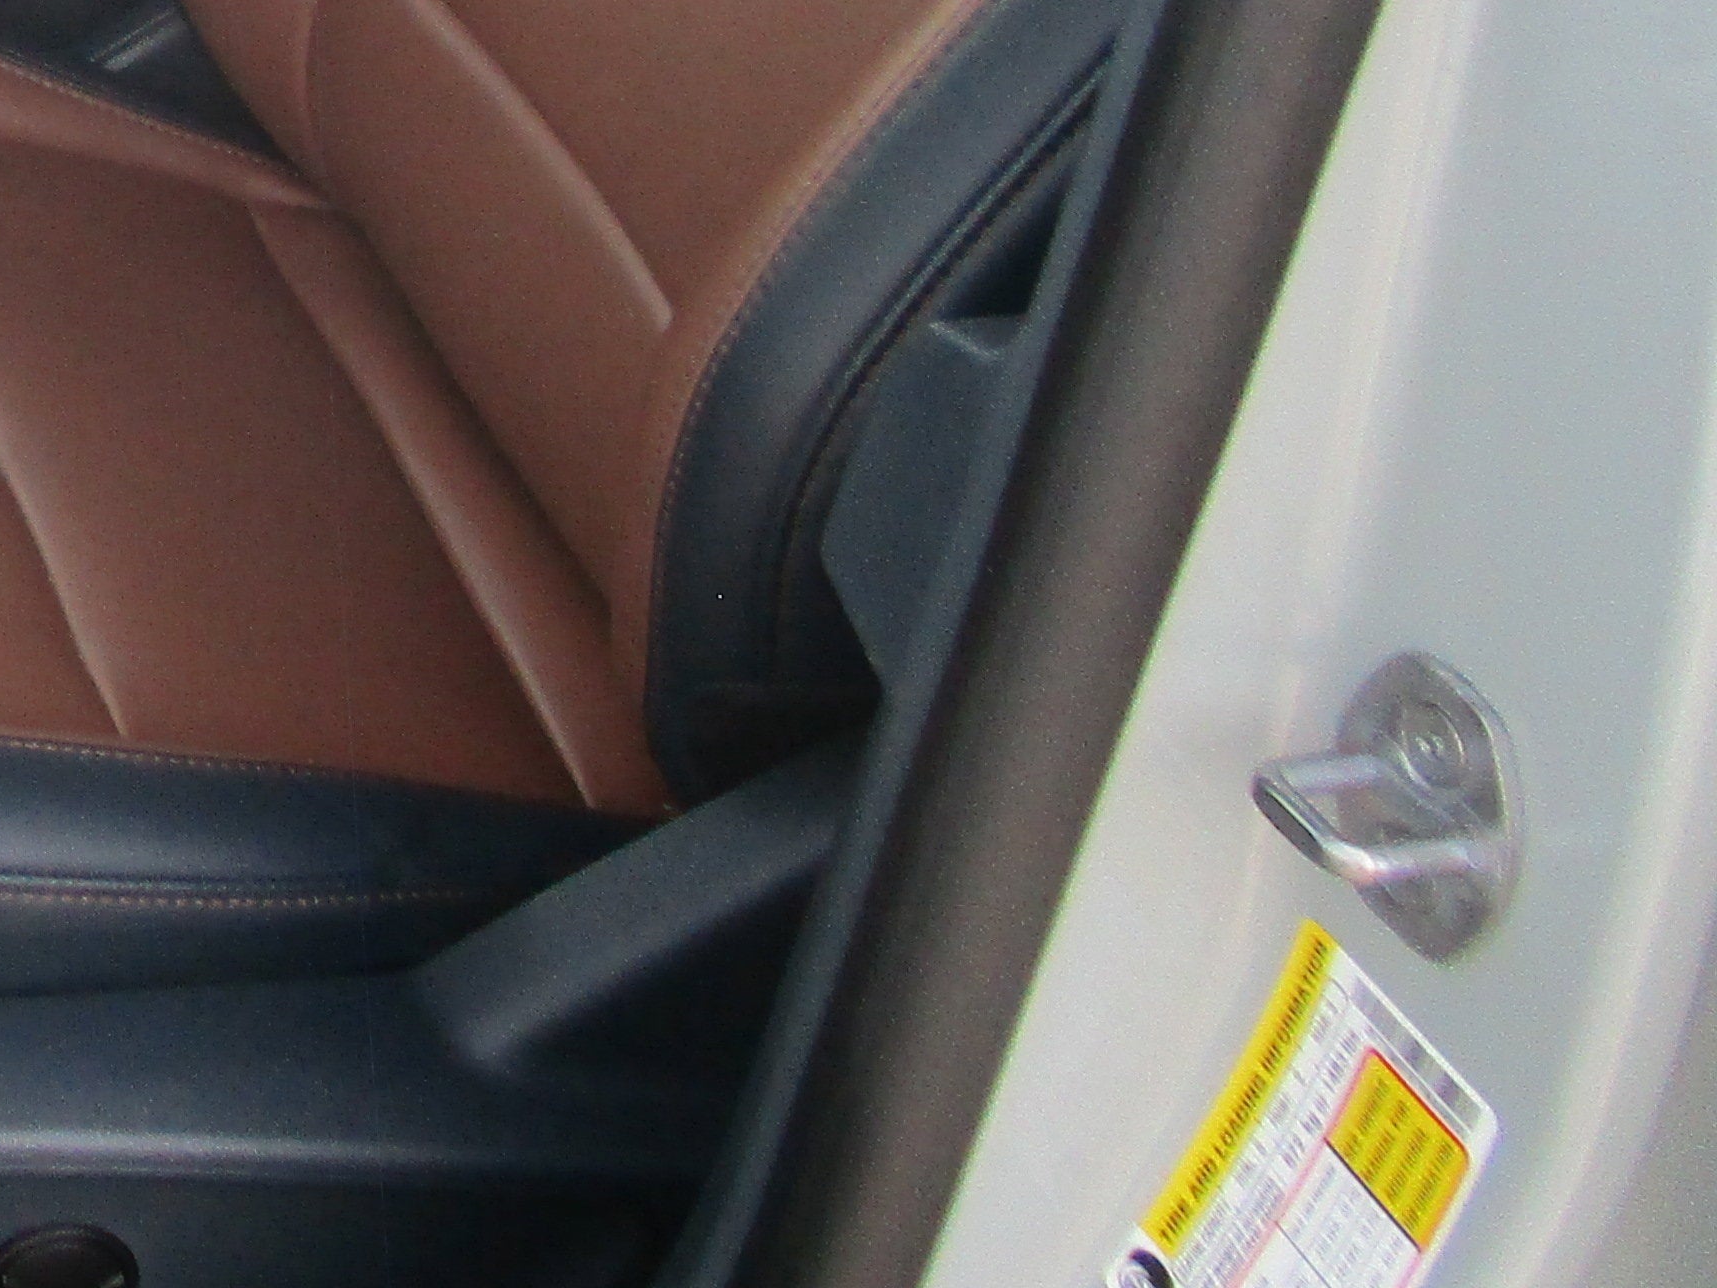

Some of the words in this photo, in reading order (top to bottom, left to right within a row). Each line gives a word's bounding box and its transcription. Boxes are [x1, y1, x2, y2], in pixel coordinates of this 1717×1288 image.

[1158, 1195, 1191, 1245] TIRE
[1188, 1155, 1216, 1203] AND
[1213, 1072, 1266, 1162] LOADING
[1260, 936, 1327, 1075] INFORMATION
